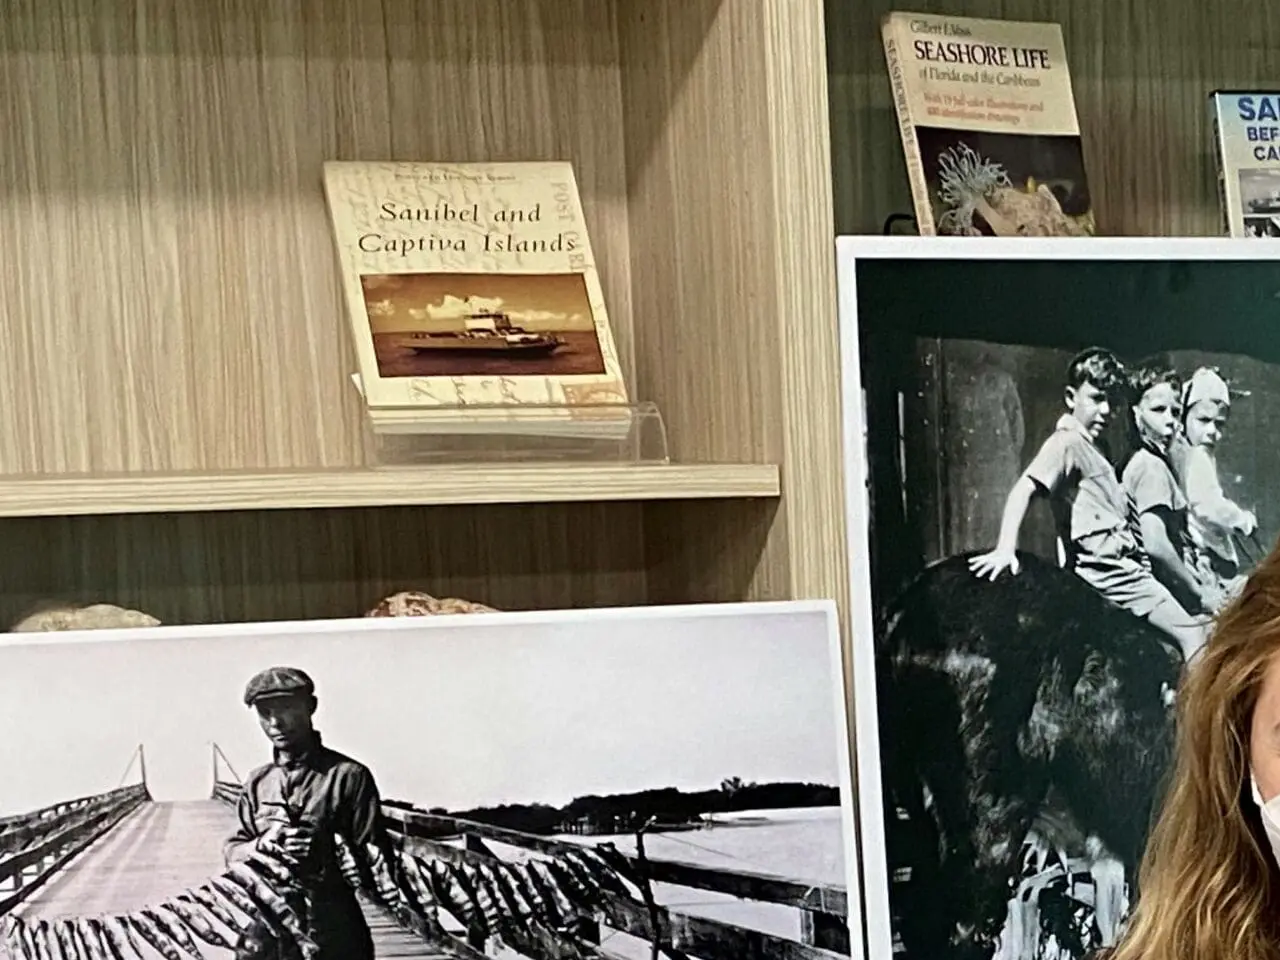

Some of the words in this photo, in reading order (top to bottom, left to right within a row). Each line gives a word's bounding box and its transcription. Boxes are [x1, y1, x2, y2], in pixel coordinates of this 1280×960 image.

[914, 40, 1009, 67] SEASHORE
[1012, 47, 1051, 69] LIFE
[929, 66, 960, 81] Florida
[962, 71, 978, 83] and
[379, 202, 479, 222] Sanibel
[494, 203, 541, 222] and
[358, 233, 466, 257] Captiva
[484, 233, 576, 252] Islands
